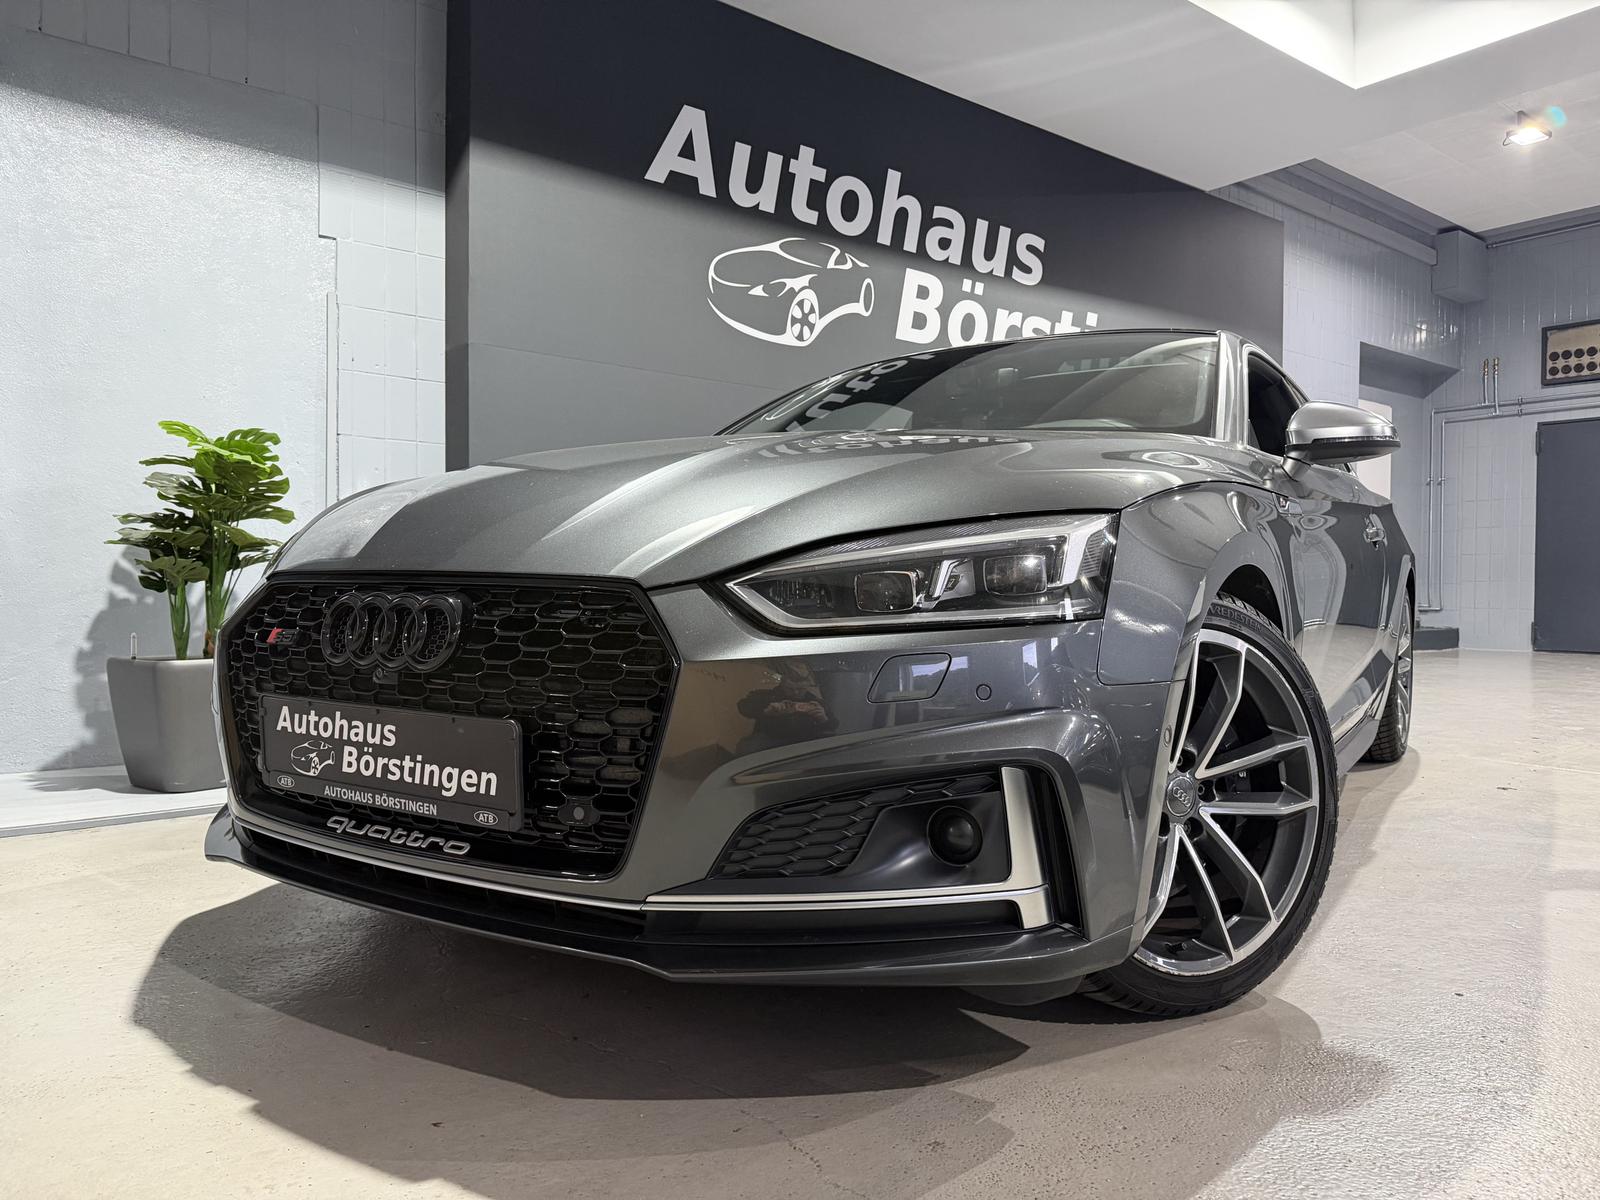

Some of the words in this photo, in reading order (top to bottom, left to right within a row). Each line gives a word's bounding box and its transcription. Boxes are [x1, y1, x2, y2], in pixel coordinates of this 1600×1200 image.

[645, 105, 1046, 286] Autohaus
[895, 267, 1099, 347] Bör
[276, 705, 396, 747] Autohaus
[279, 776, 293, 787] ATB
[342, 745, 498, 797] Börstingen
[324, 785, 373, 805] AUTOHAUS
[375, 793, 437, 816] BÖRSTINGEN
[477, 812, 495, 825] ATB
[326, 815, 471, 855] quattro
